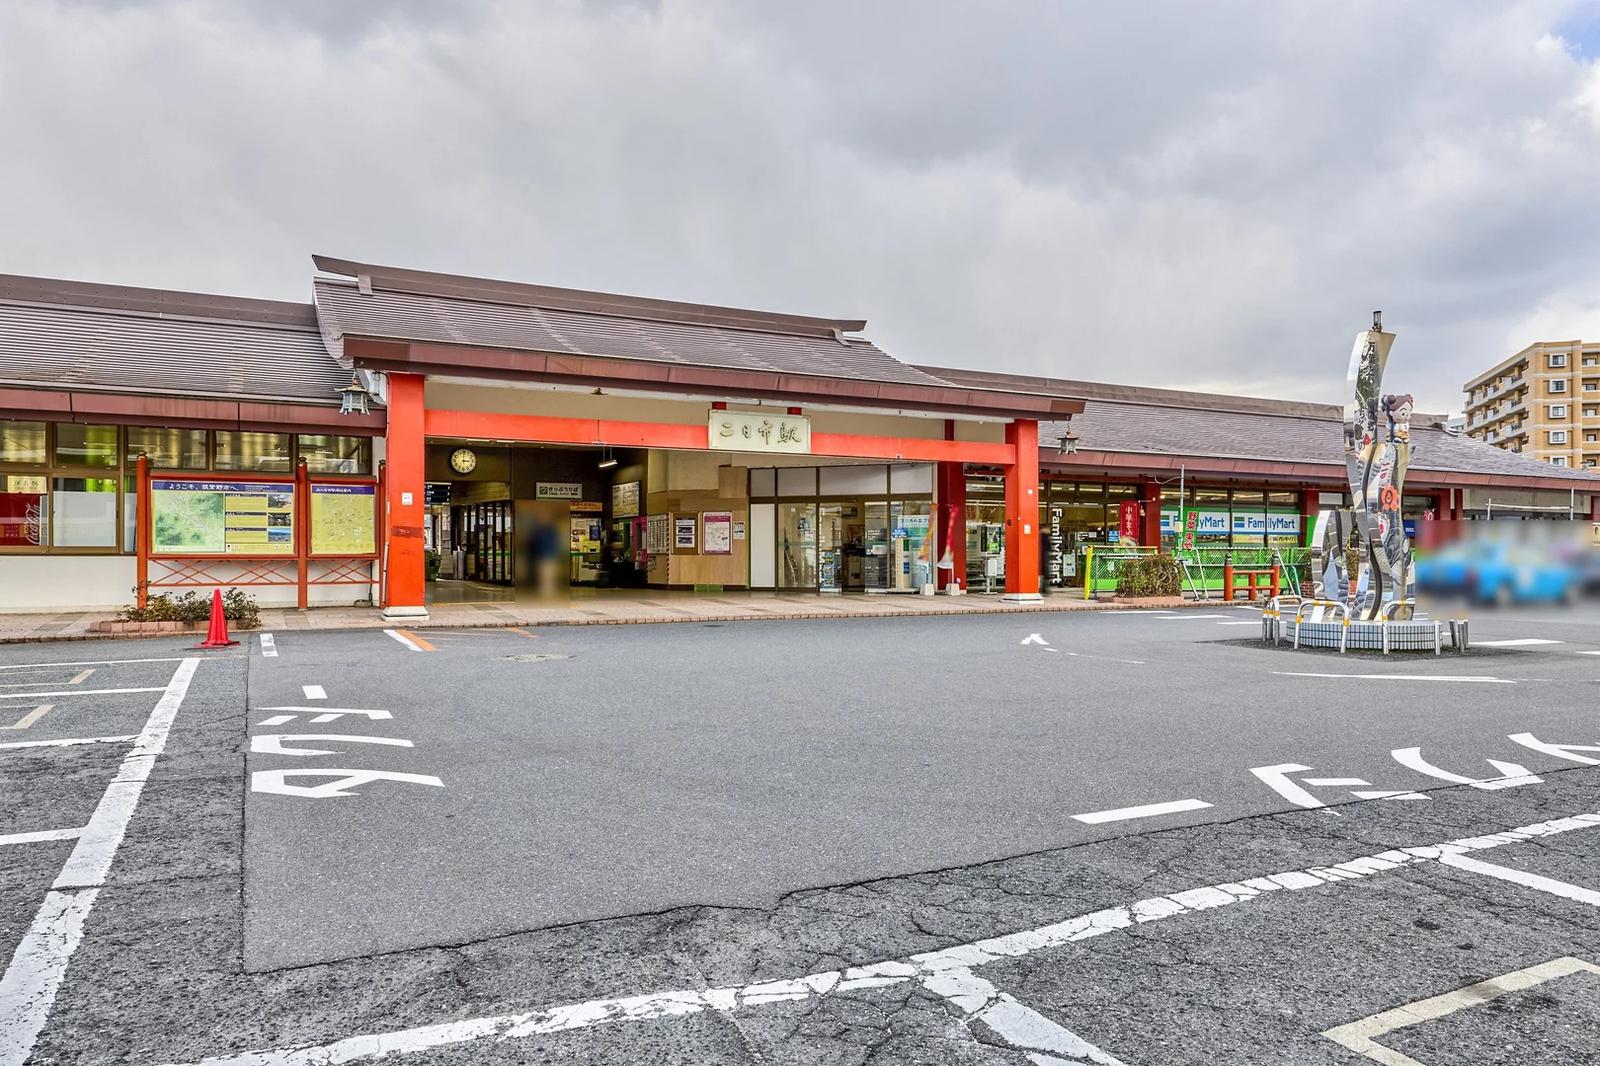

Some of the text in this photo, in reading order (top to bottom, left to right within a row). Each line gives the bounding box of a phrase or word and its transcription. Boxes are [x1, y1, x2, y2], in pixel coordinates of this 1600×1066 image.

[719, 419, 803, 446] 二日市駅
[1247, 517, 1296, 531] FamilyMart
[1050, 507, 1063, 585] FamilyMart
